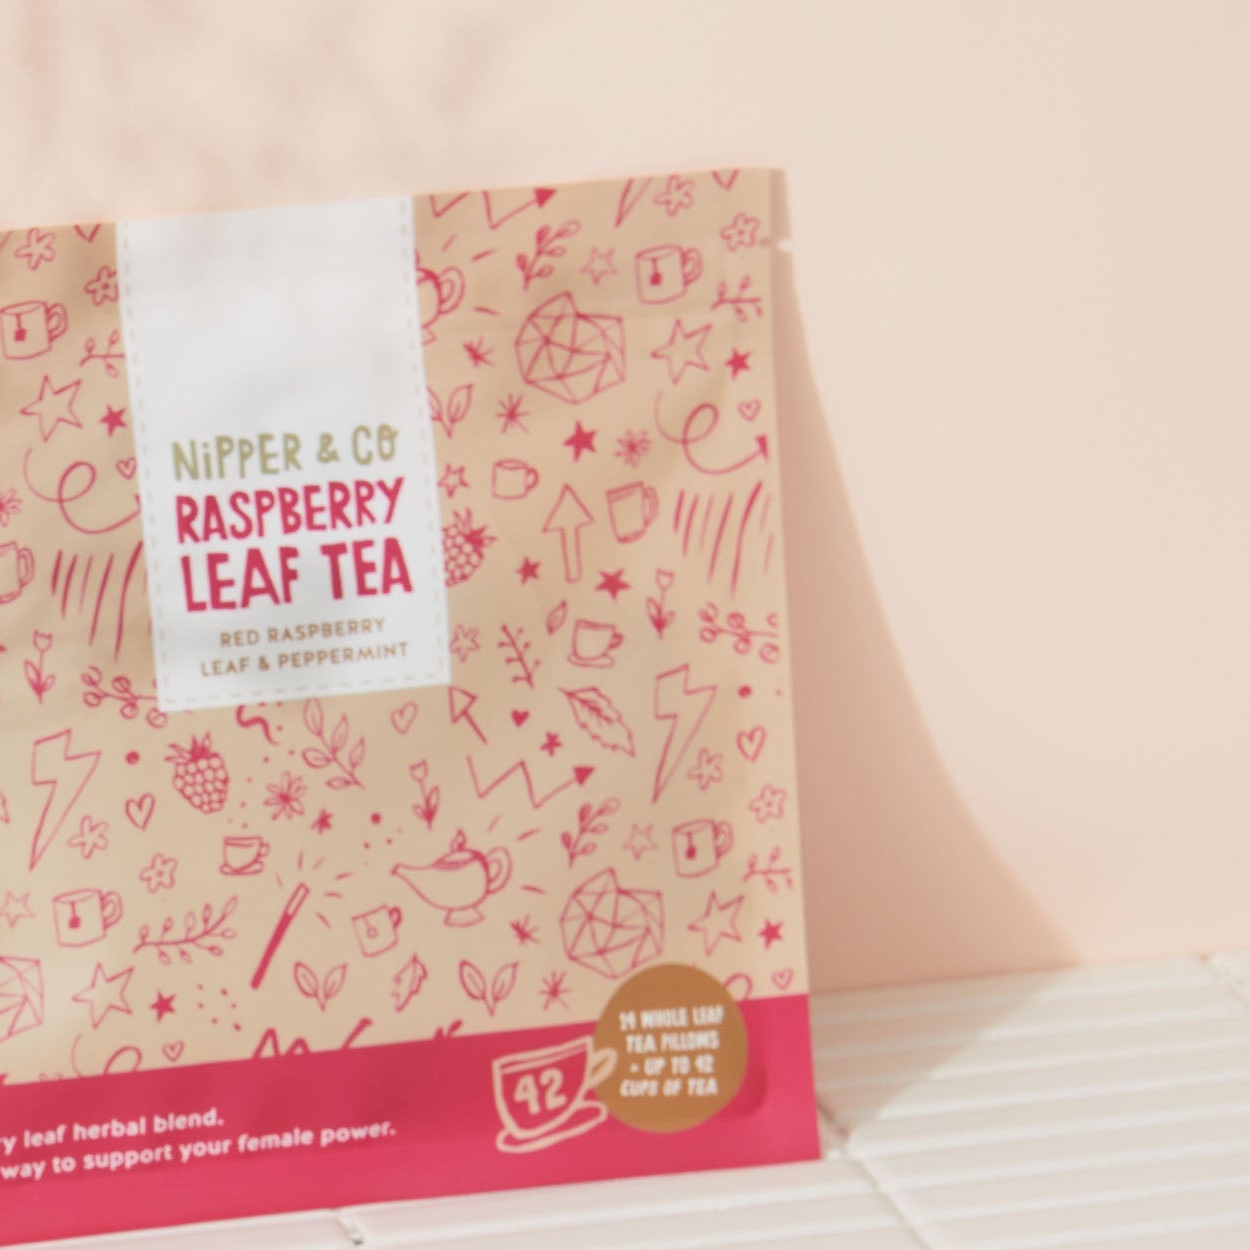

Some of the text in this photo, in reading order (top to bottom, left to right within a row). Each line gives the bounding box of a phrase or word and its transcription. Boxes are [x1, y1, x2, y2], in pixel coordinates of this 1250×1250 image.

[317, 433, 340, 463] &
[176, 477, 405, 544] RASPBERRY
[181, 537, 413, 612] LEAF TEA
[220, 617, 385, 648] RED RASPBERRY
[201, 641, 409, 677] LEAF & PEPPERMINT
[692, 1005, 724, 1025] LEAF
[626, 1034, 656, 1054] TEA
[644, 1057, 665, 1077] UP
[671, 1056, 690, 1074] TO
[695, 1054, 714, 1073] 42
[513, 1068, 567, 1115] 42
[620, 1078, 718, 1098] CUPS OF TEA
[23, 1125, 66, 1148] leaf
[73, 1117, 147, 1143] herbal
[153, 1108, 224, 1133] blend.
[0, 1162, 47, 1181] way
[52, 1152, 76, 1174] to
[83, 1144, 173, 1171] support
[180, 1138, 232, 1163] your
[238, 1126, 314, 1153] female
[320, 1121, 396, 1145] power.
